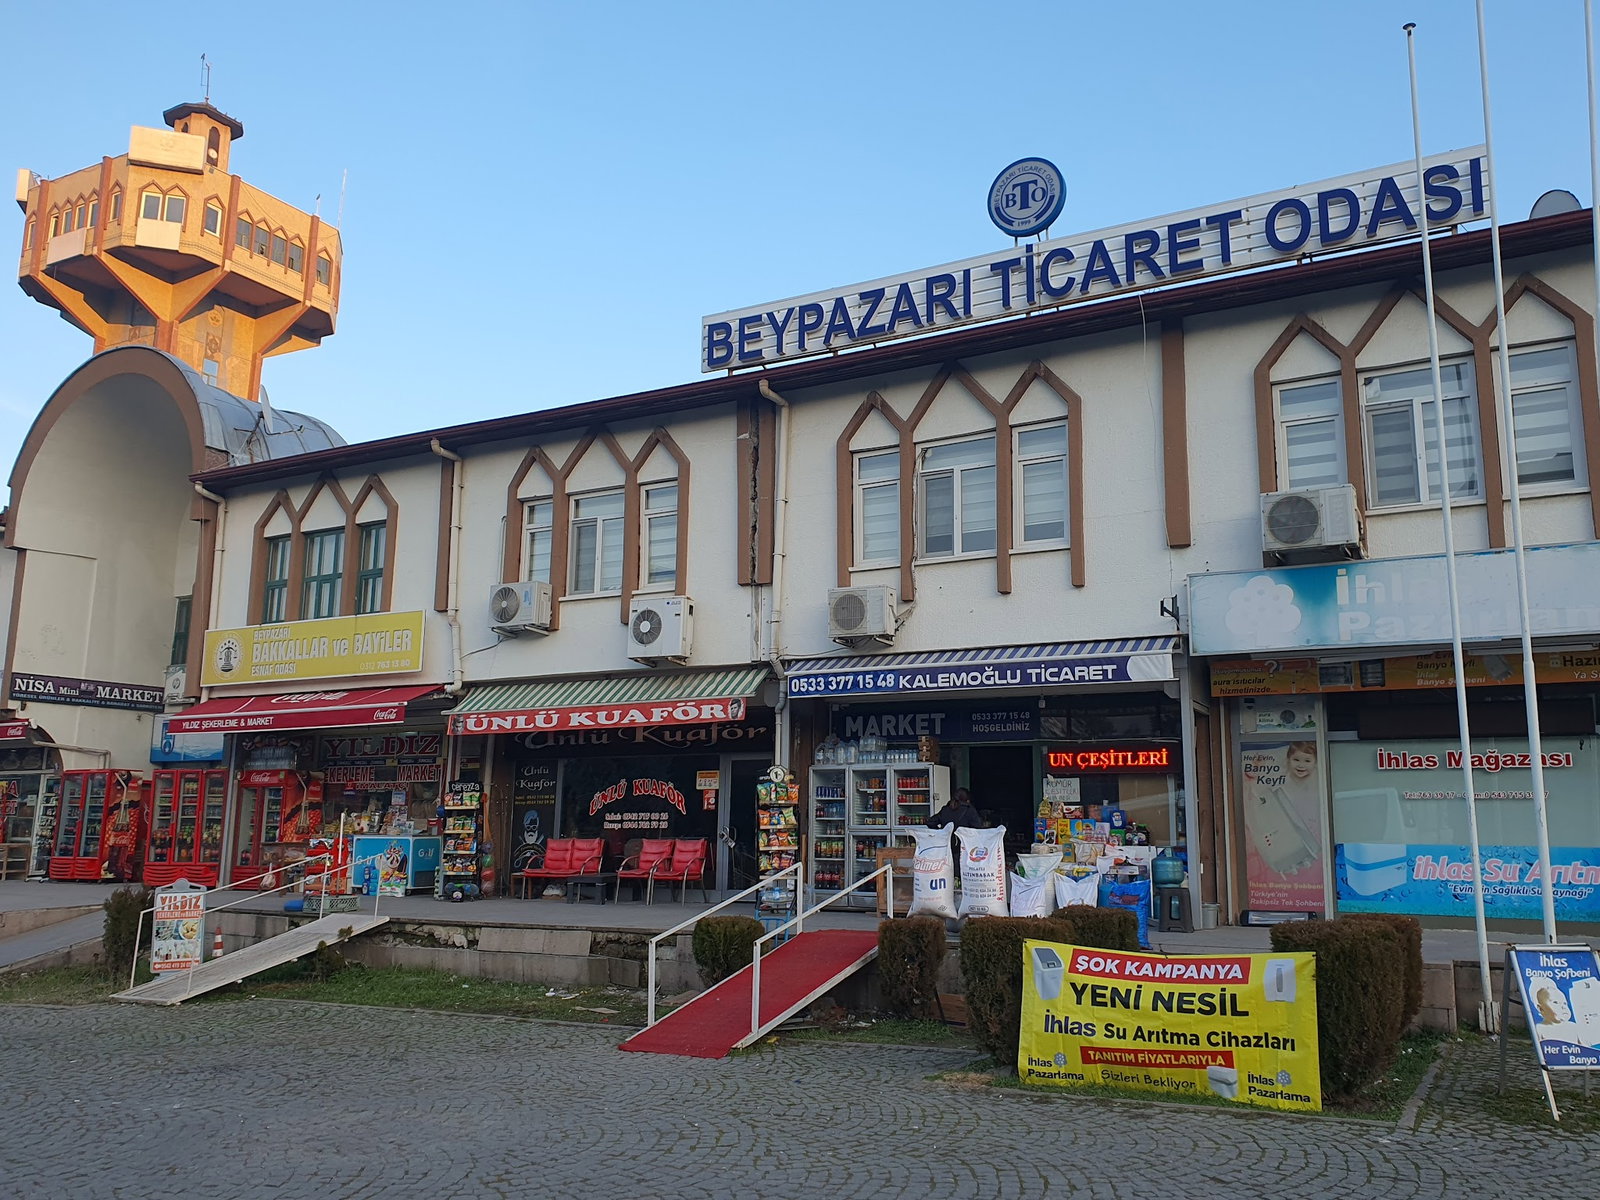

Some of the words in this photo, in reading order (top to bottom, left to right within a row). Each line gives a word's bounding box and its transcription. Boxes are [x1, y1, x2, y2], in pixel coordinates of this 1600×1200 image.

[1005, 179, 1048, 210] BTO
[707, 268, 974, 367] BEYPAZARI
[990, 209, 1243, 310] TİCARET
[1265, 157, 1484, 253] ODASI
[252, 636, 328, 663] BAKKALLAR
[332, 638, 348, 657] ve
[354, 629, 413, 655] BAYİLER
[251, 664, 273, 676] ESNAF
[377, 660, 389, 669] 763
[792, 678, 824, 693] 0533
[828, 676, 854, 691] 377
[857, 675, 874, 689] 15
[876, 673, 894, 687] 48
[899, 666, 1021, 689] KALEMOĞLU
[1027, 664, 1117, 682] TİCARET
[14, 676, 55, 693] NİSA
[59, 686, 79, 696] Mini
[96, 686, 162, 703] MARKET
[182, 720, 200, 729] YILDIZ
[201, 718, 238, 729] ŞEKERLEME
[240, 718, 245, 726] &
[247, 716, 274, 726] MARKET
[465, 711, 560, 731] ÜNLÜ
[568, 702, 727, 727] KUAFÖR
[972, 712, 991, 721] 0533
[992, 711, 1007, 720] 377
[1009, 711, 1018, 720] 15
[1020, 711, 1030, 719] 48
[845, 713, 946, 737] MARKET
[972, 722, 1030, 733] HOŞGELDİNİZ
[324, 734, 440, 758] YILDIZ
[1049, 753, 1073, 767] UN
[1077, 748, 1168, 769] ÇEŞİTLERİ
[1378, 748, 1439, 769] İhlas
[397, 764, 441, 782] MARKET
[1244, 763, 1280, 774] Banyo
[1257, 775, 1286, 786] Keyfi
[589, 779, 627, 815] ÜNLÜ
[633, 778, 687, 815] KUAFÖR
[1413, 855, 1475, 881] ihlas
[1483, 859, 1521, 882] Su
[930, 878, 946, 890] un
[1493, 886, 1529, 896] Sağlıklı
[1531, 887, 1542, 895] Su
[1076, 955, 1121, 974] ŞOK
[1124, 961, 1243, 979] KAMPANYA
[1540, 953, 1568, 967] İhlas
[1526, 968, 1552, 978] Banyo
[1555, 968, 1591, 980] Şofbeni
[1069, 982, 1143, 1010] YENİ
[1151, 988, 1249, 1017] NESİL
[1044, 1009, 1096, 1037] İhlas
[1104, 1023, 1127, 1040] Su
[1133, 1026, 1200, 1046] Arıtma
[1206, 1031, 1296, 1052] Cihazları
[1088, 1050, 1135, 1063] TANITIM
[1138, 1051, 1226, 1065] FİYATLARIYLA
[1544, 1045, 1560, 1054] Her
[1562, 1045, 1581, 1054] Evin
[1028, 1055, 1053, 1068] İhlas
[1569, 1055, 1598, 1066] Banyo
[1028, 1069, 1084, 1081] Pazarlama
[1101, 1069, 1140, 1084] Sizleri
[1144, 1074, 1195, 1090] Bekliyor
[1248, 1072, 1274, 1086] İhlas
[1248, 1086, 1311, 1103] Pazarlama
